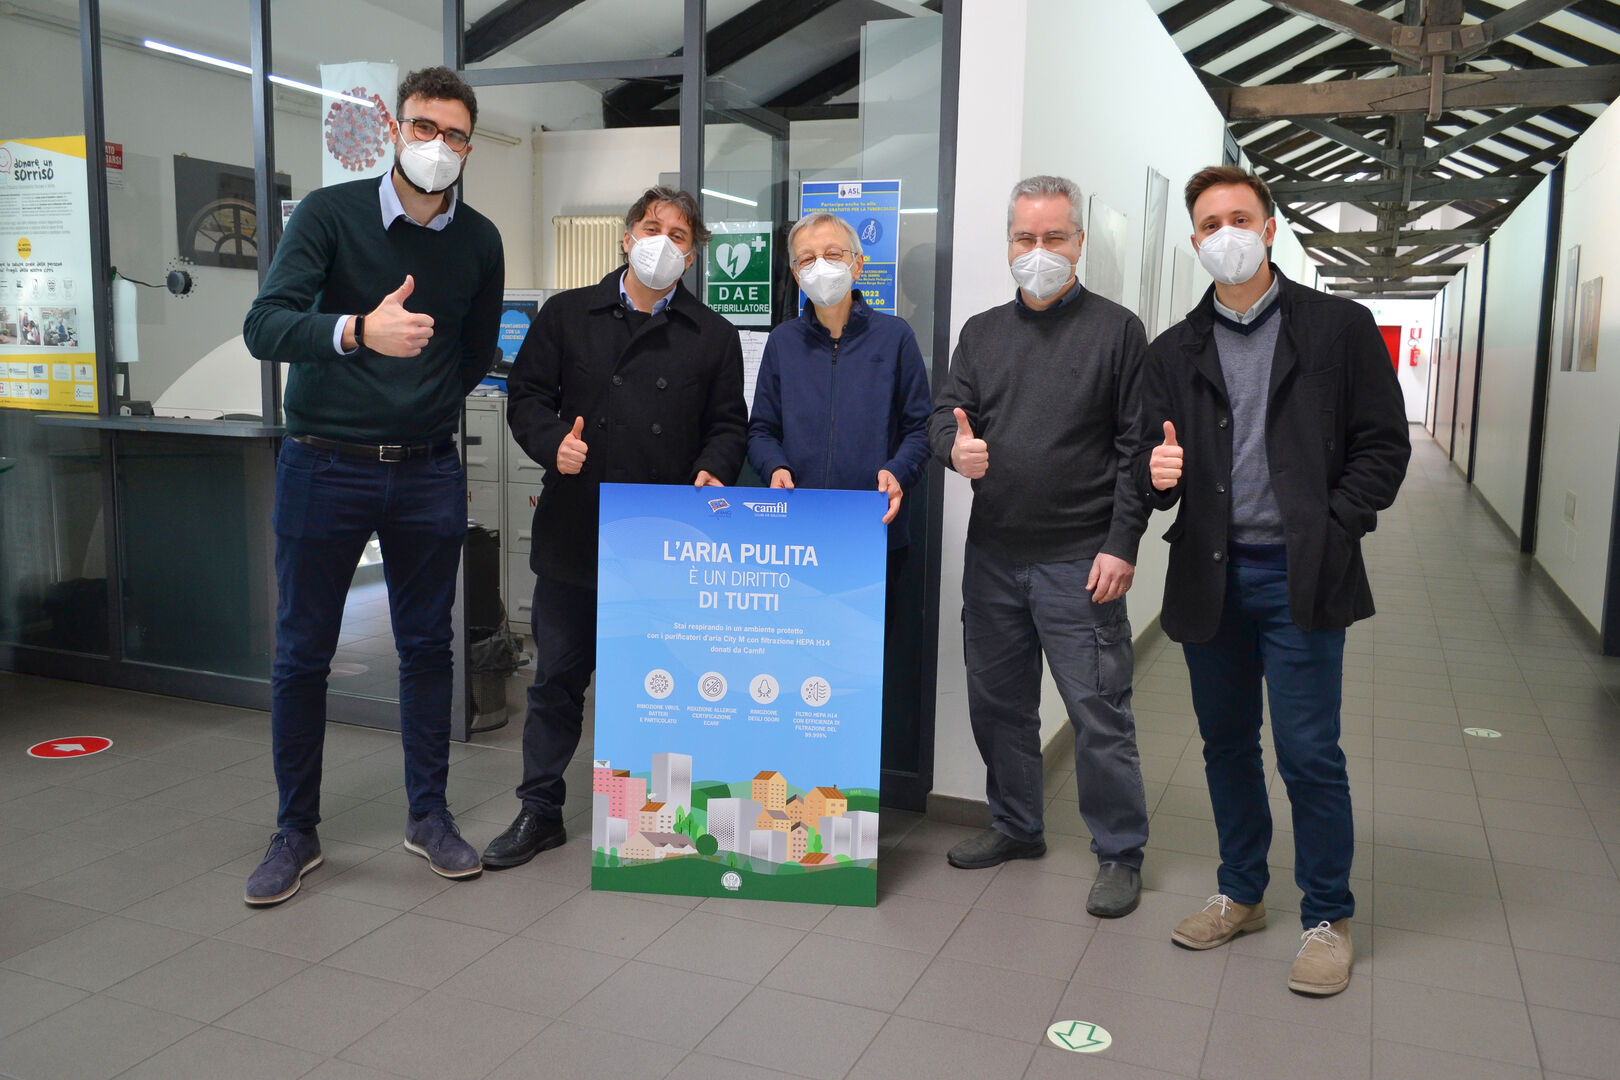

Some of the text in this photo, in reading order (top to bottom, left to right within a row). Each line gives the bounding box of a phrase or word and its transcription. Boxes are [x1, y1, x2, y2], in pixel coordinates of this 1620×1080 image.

[14, 158, 40, 169] donare
[14, 167, 54, 181] sorriso
[719, 287, 759, 300] DAE
[708, 304, 770, 312] DEFIBRILLATORE
[754, 501, 788, 513] camfil
[663, 541, 818, 566] L'ARIA PULITA
[689, 565, 791, 589] È UN DIRITTO
[699, 591, 779, 611] DI TUTTI
[673, 622, 687, 630] Stai
[688, 623, 723, 632] respirando
[664, 633, 701, 641] purificatori
[703, 634, 722, 642] d'aria
[723, 635, 737, 643] City
[760, 637, 794, 645] filtrazione
[796, 638, 815, 646] HEPA
[743, 647, 766, 655] Camfil
